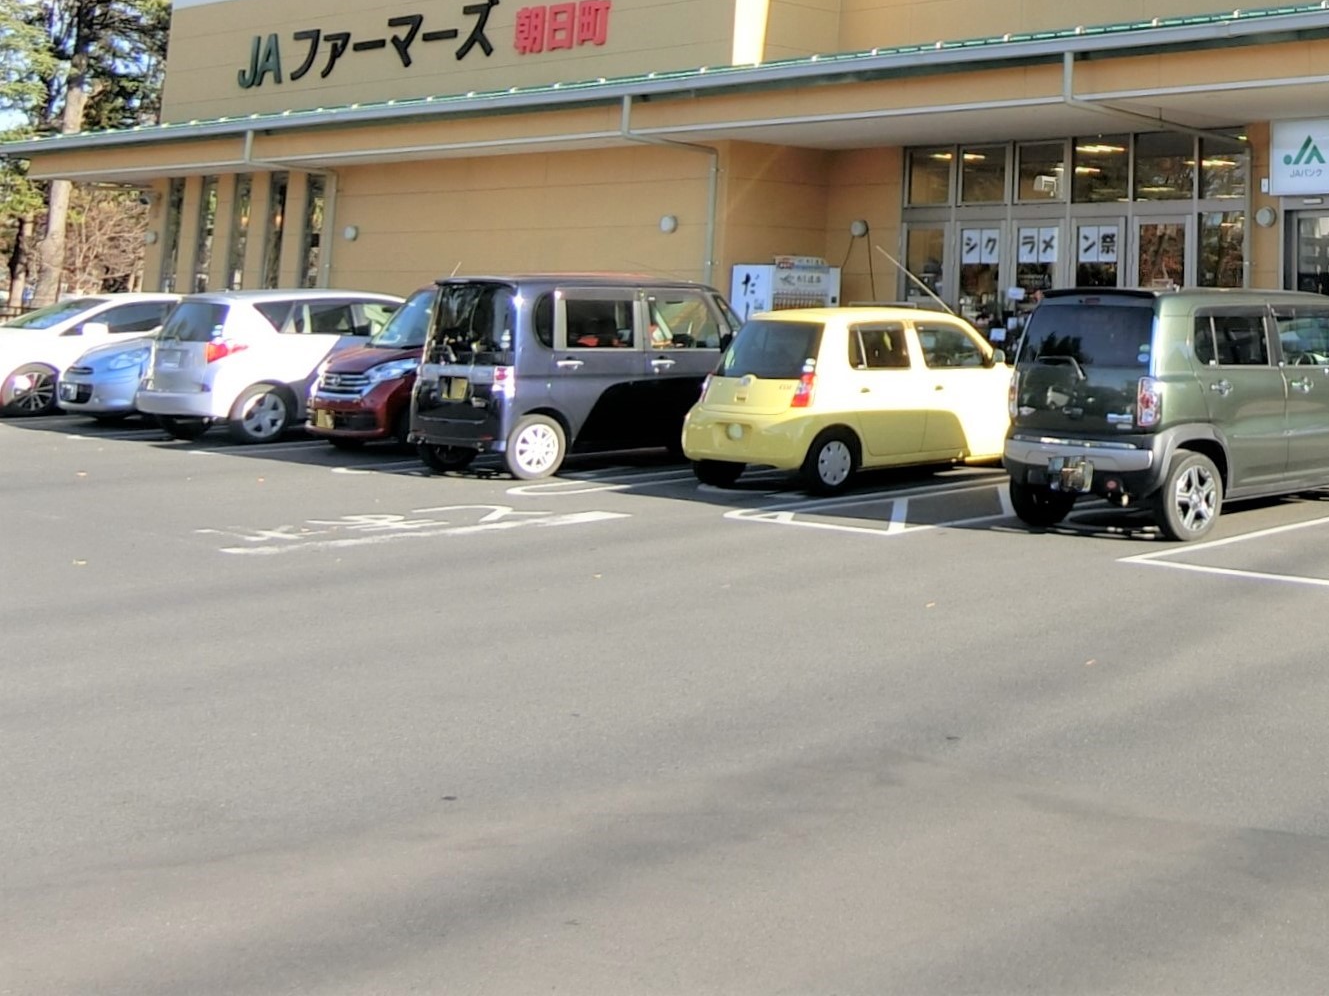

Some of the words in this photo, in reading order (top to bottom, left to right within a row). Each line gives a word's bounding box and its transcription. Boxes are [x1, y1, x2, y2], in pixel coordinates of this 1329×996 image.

[514, 0, 612, 55] 朝日町
[1289, 169, 1323, 178] JAバンク
[964, 233, 1116, 254] シクラメン祭
